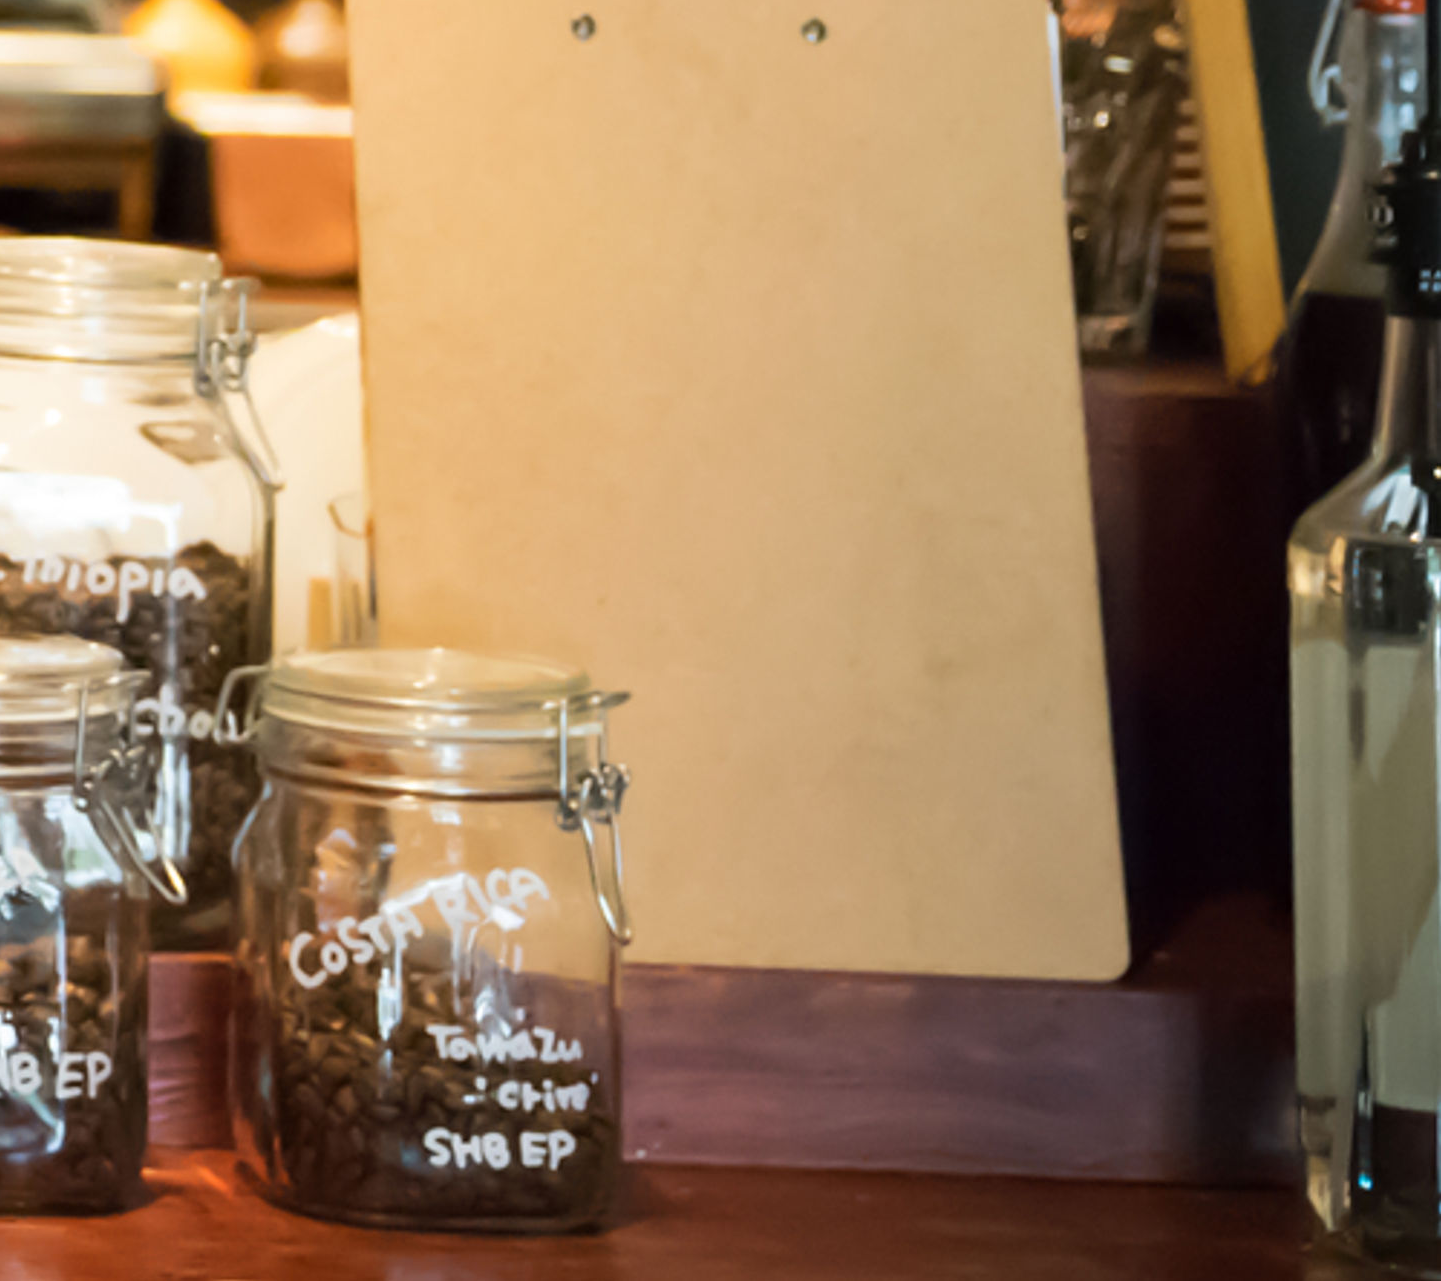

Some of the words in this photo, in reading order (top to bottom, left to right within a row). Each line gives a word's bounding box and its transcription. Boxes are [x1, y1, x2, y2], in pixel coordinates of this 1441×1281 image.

[289, 906, 424, 990] COSTA
[429, 867, 551, 928] RICA
[55, 1050, 114, 1100] EP
[425, 1127, 513, 1171] SHB
[519, 1128, 578, 1171] EP
